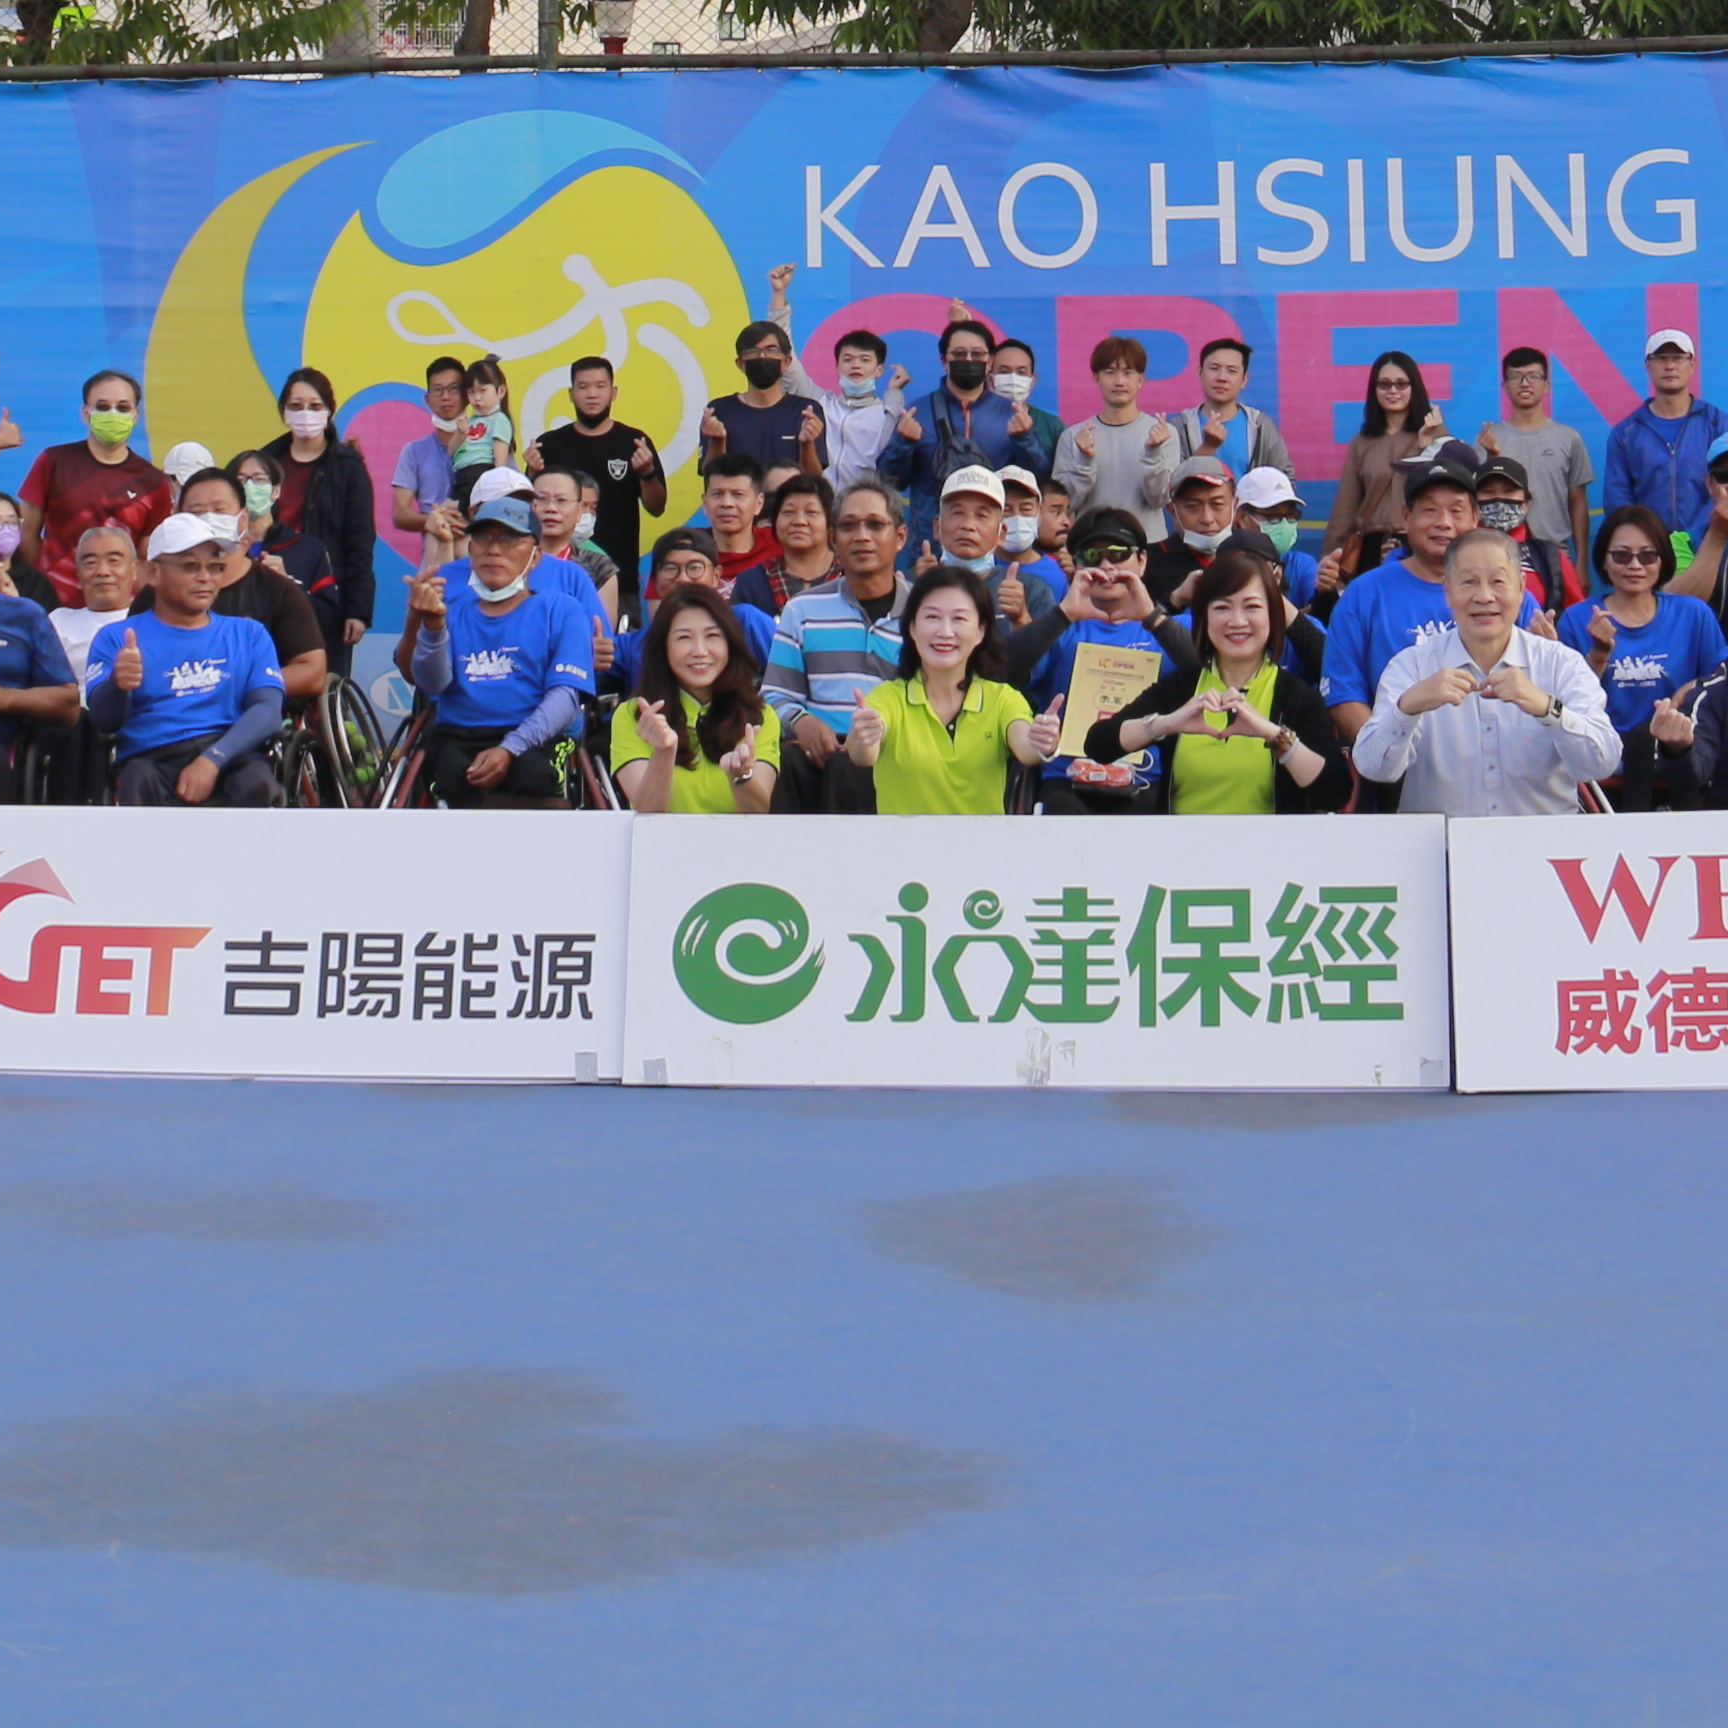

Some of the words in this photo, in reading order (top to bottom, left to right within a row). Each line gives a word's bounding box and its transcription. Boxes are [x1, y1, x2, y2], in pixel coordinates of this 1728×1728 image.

[806, 161, 1098, 269] KAO
[1151, 148, 1698, 266] HSIUNG
[797, 282, 1699, 482] OPEN
[222, 929, 597, 1021] 吉陽能源
[844, 881, 1405, 1028] 永達保經
